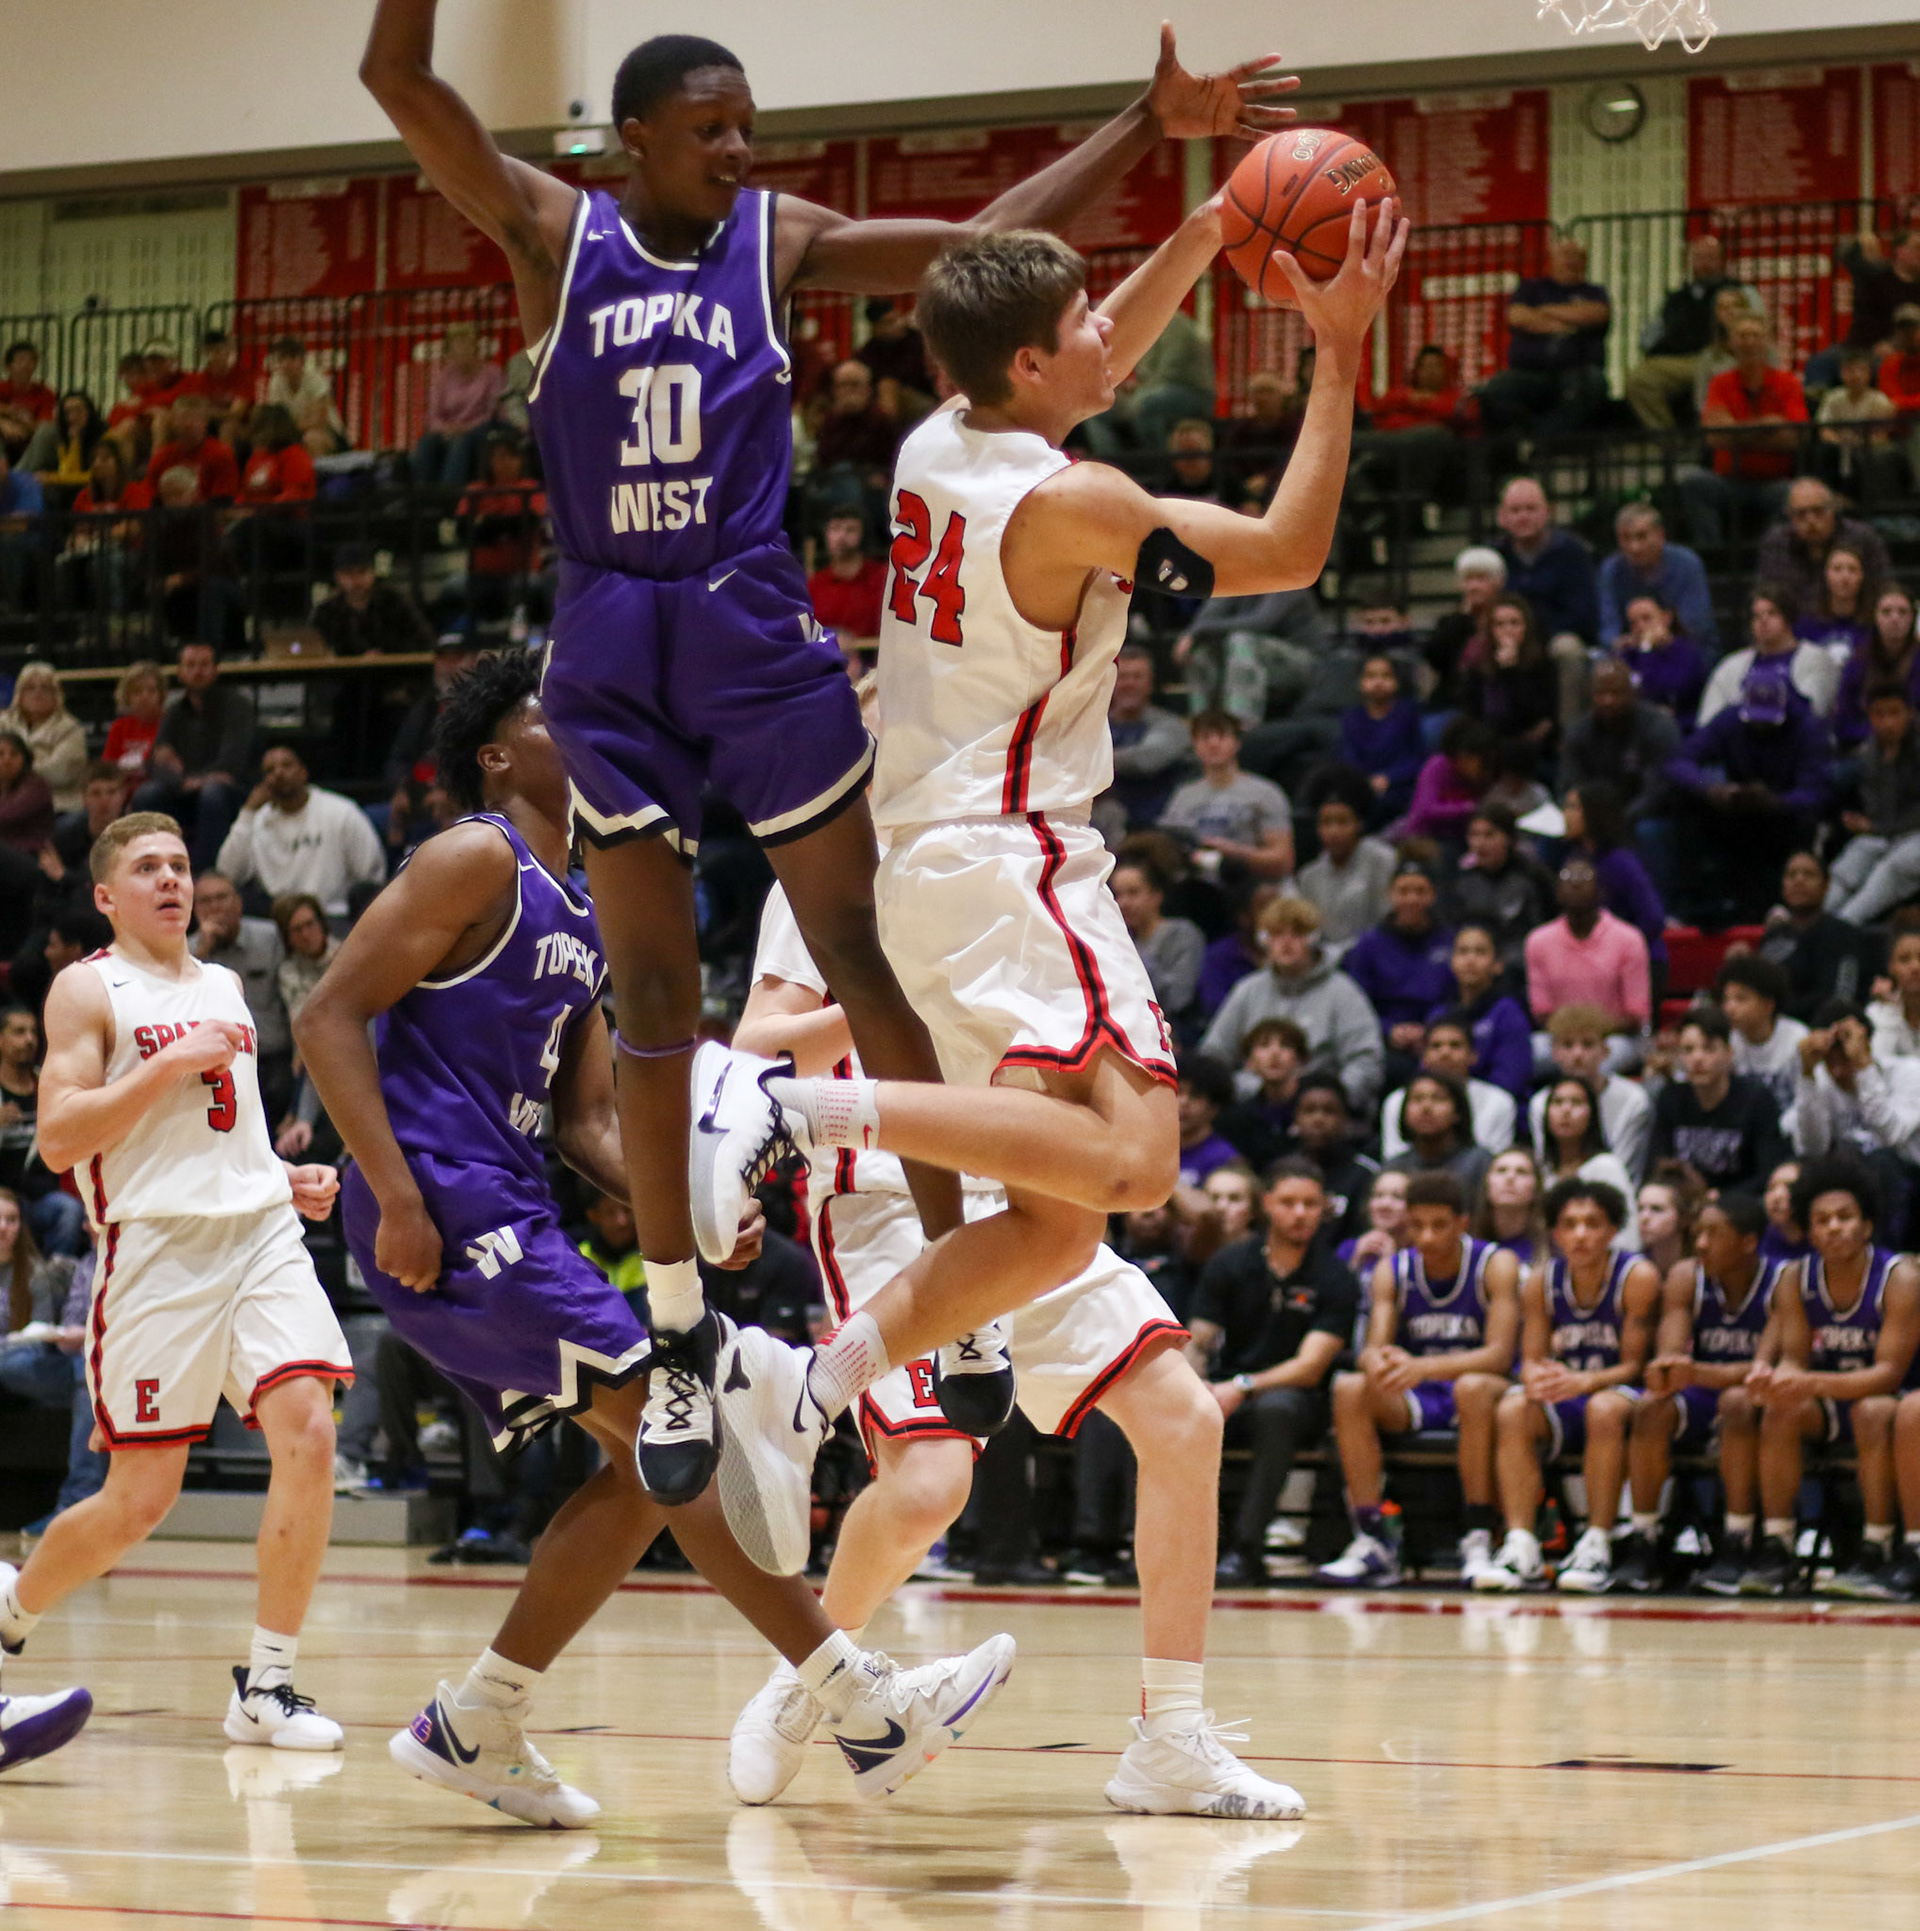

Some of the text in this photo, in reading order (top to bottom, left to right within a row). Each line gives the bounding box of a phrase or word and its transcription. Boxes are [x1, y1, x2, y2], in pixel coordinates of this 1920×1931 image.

[589, 292, 736, 361] TOPKA
[619, 364, 702, 466] 30
[611, 476, 714, 534] WEST
[889, 488, 966, 648] 24
[539, 1004, 574, 1090] 4
[201, 1067, 237, 1133] 3
[135, 1378, 160, 1423] E
[905, 1359, 939, 1409] E
